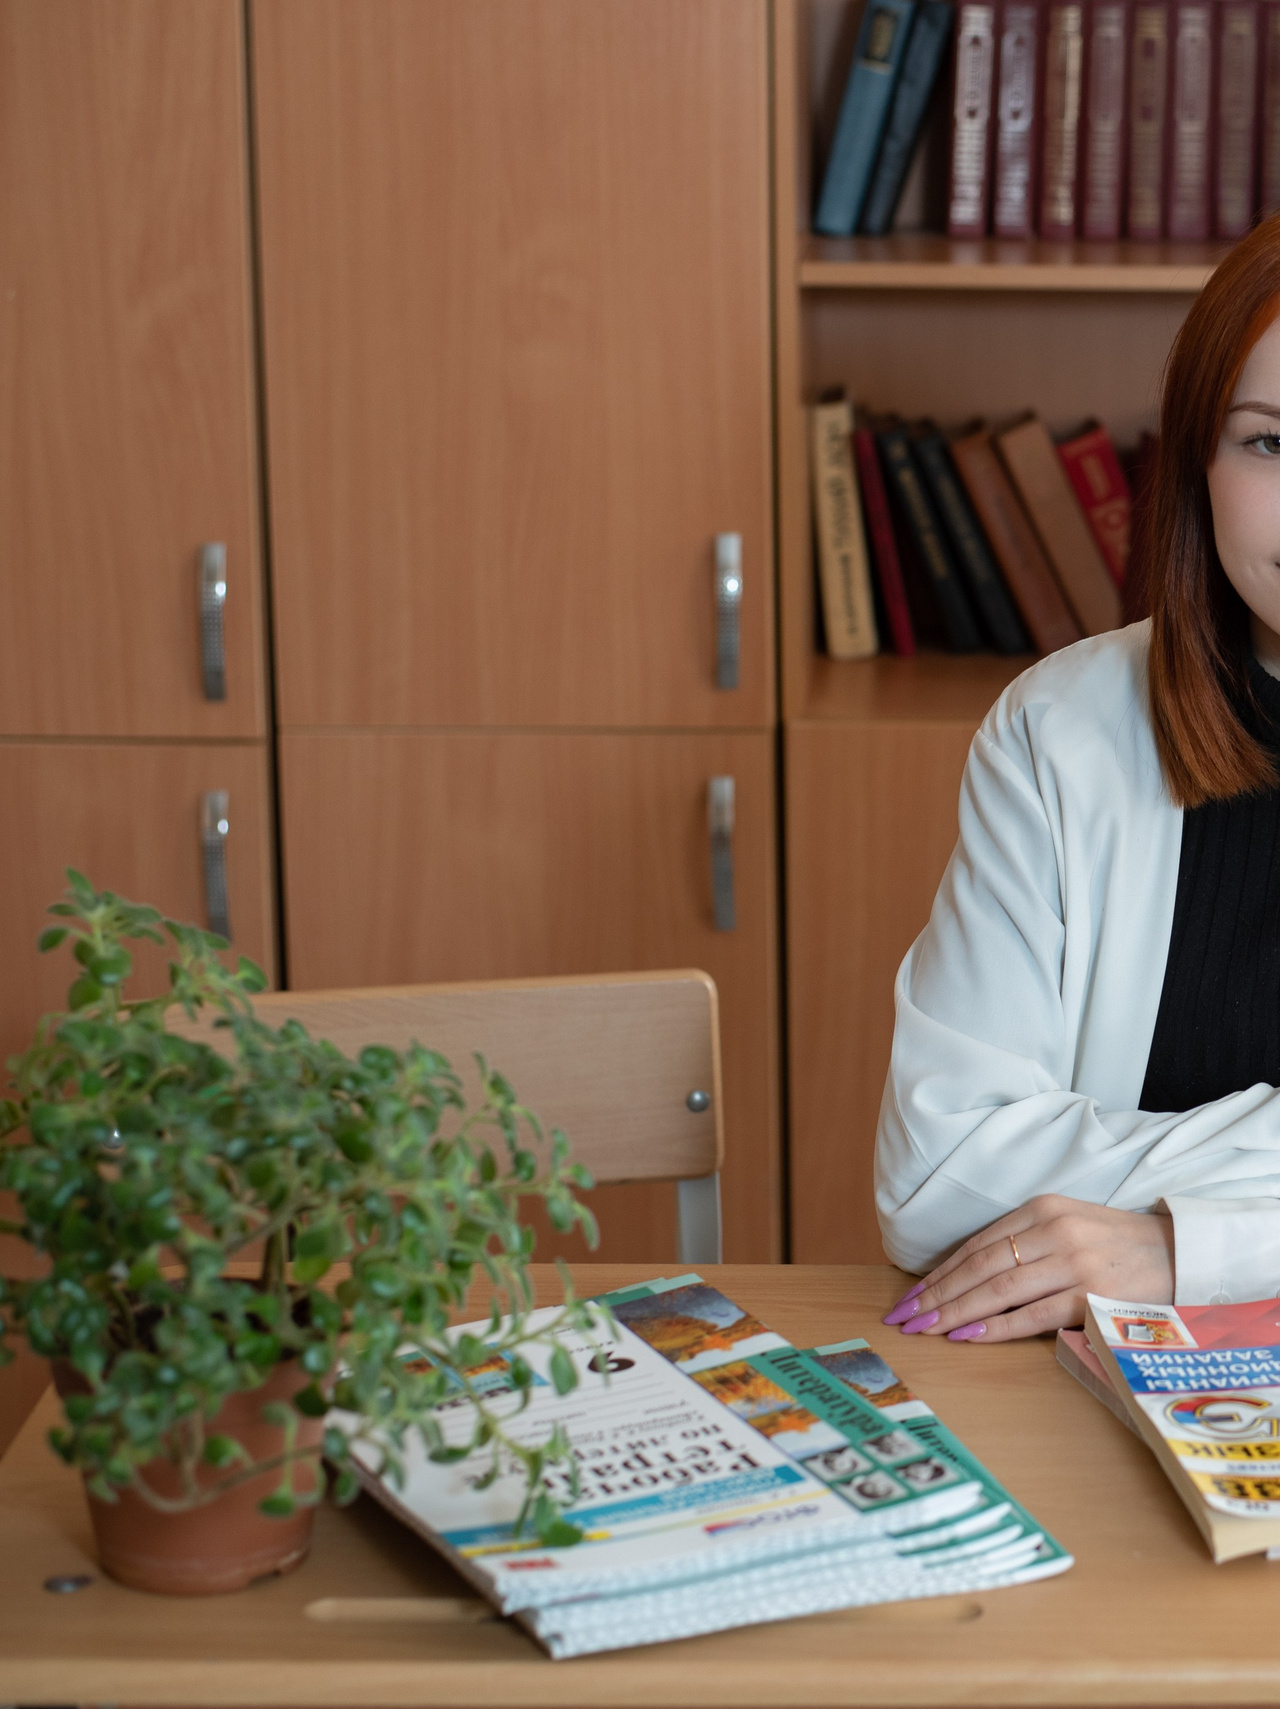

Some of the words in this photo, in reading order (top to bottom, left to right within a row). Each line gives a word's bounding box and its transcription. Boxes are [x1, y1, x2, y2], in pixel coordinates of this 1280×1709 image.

[587, 1350, 637, 1374] 9
[1130, 1348, 1273, 1366] ЗАДАНИЙ
[761, 1351, 885, 1437] Литература
[560, 1453, 760, 1503] Рабоча
